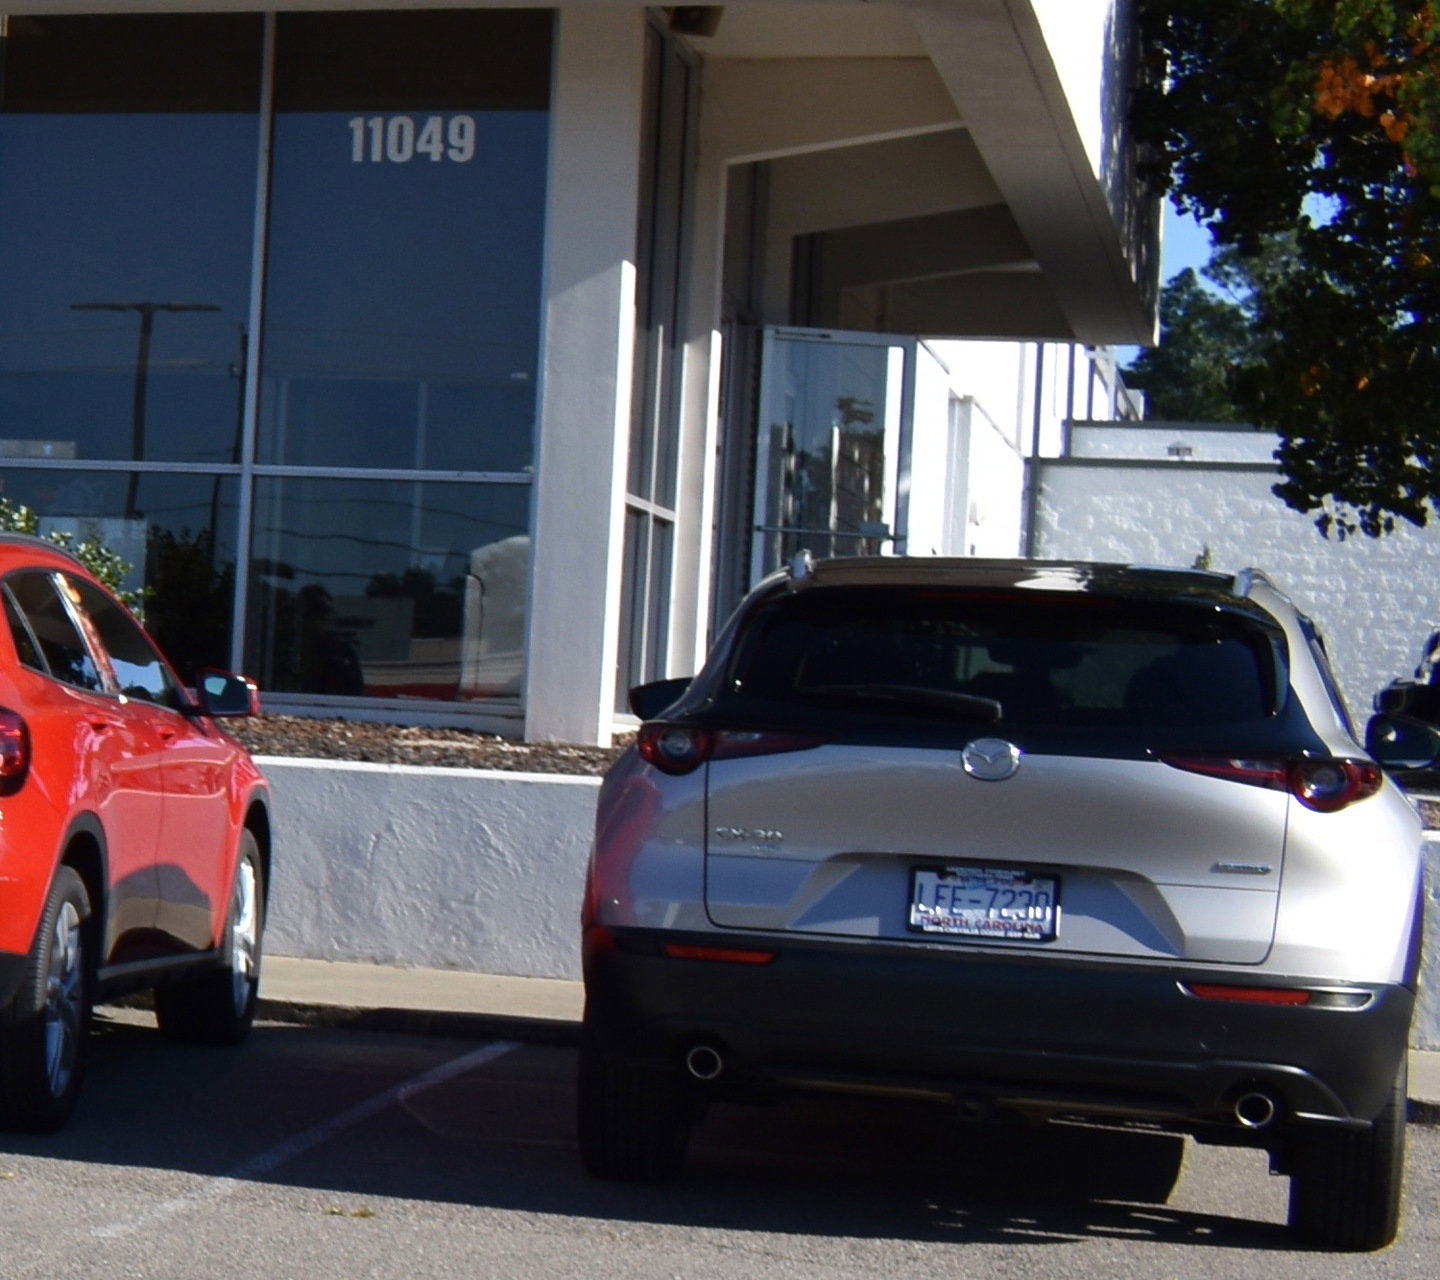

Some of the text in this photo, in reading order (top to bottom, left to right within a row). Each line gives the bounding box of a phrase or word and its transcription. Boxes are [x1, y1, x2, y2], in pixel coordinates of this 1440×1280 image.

[348, 115, 477, 163] 11049
[915, 882, 1051, 923] LFE-7230
[920, 915, 969, 929] NORTH
[974, 919, 1044, 935] CAROLINA
